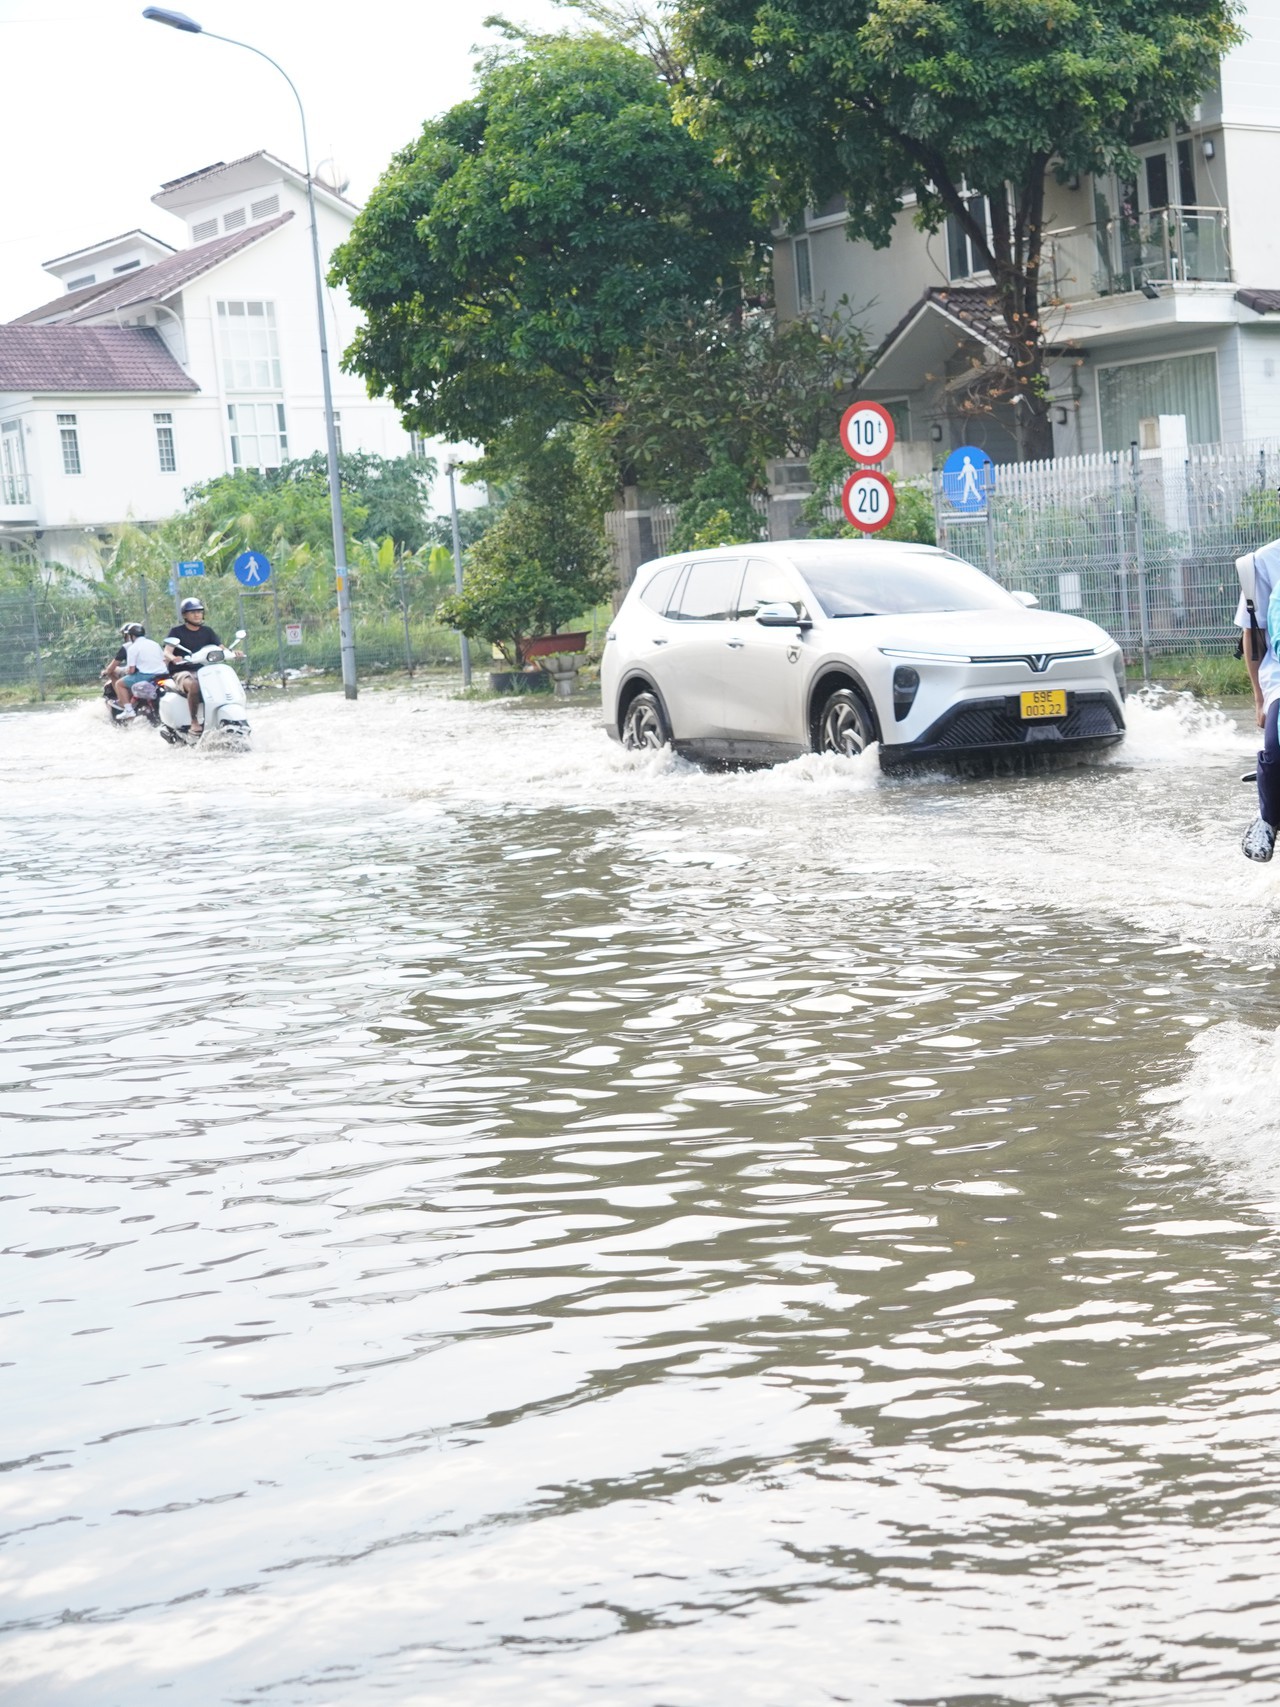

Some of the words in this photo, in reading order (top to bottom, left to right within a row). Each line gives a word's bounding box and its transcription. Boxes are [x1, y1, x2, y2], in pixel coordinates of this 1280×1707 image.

[858, 487, 879, 513] 20
[1033, 691, 1053, 703] 69E
[1026, 704, 1061, 716] 003.22
